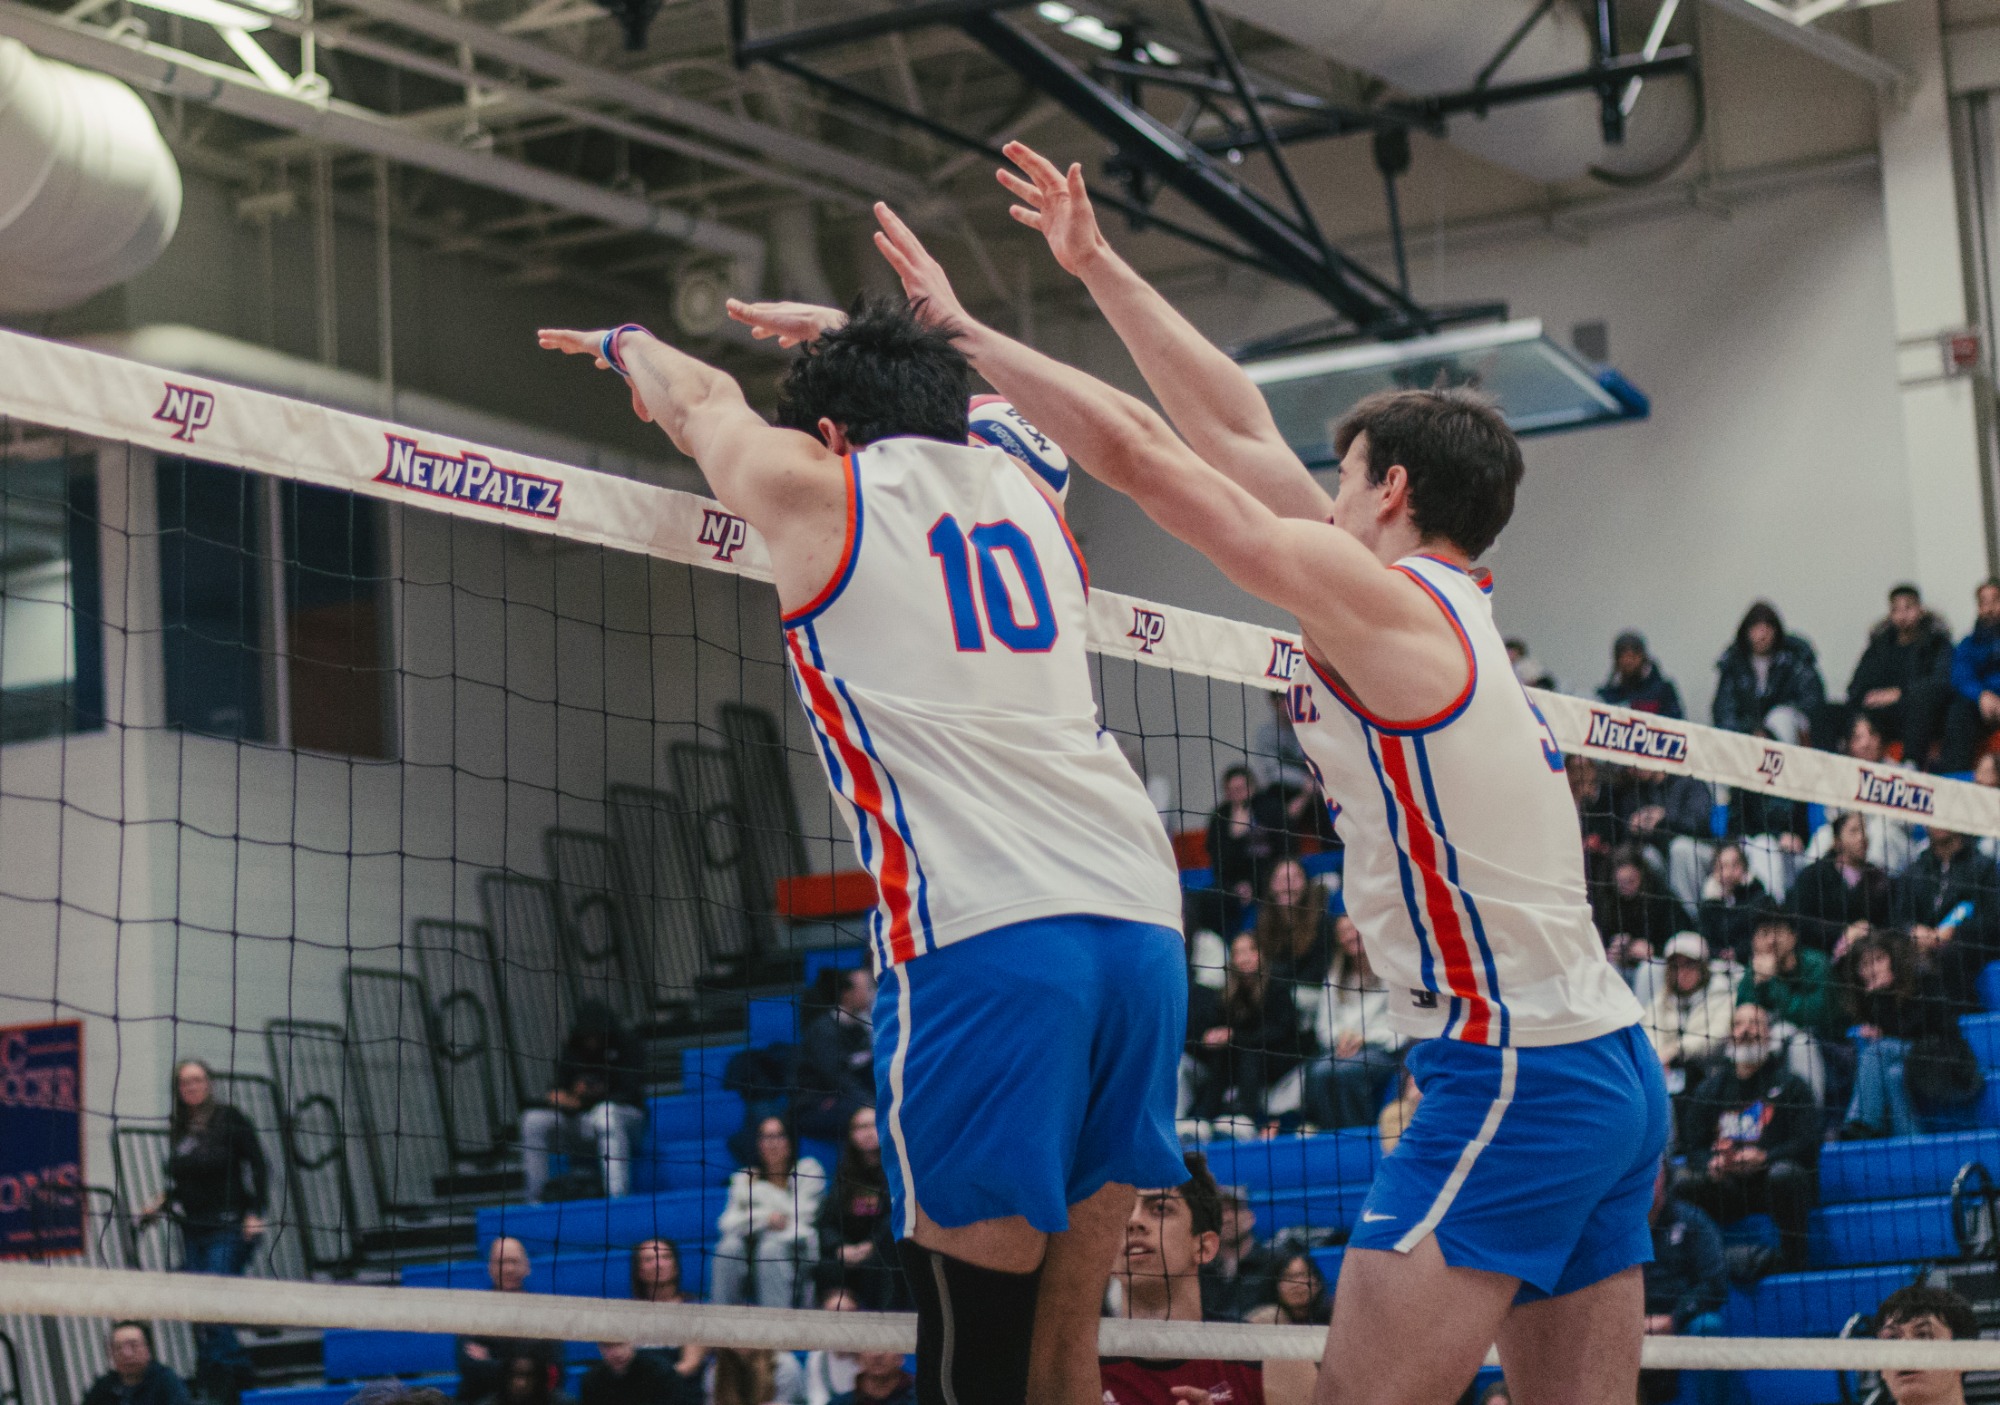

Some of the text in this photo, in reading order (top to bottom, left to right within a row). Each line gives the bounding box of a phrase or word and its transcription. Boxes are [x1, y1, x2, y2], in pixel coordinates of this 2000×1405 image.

[153, 382, 214, 442] NP
[697, 509, 746, 562] NP
[927, 512, 1059, 653] 10
[1126, 607, 1165, 654] NP
